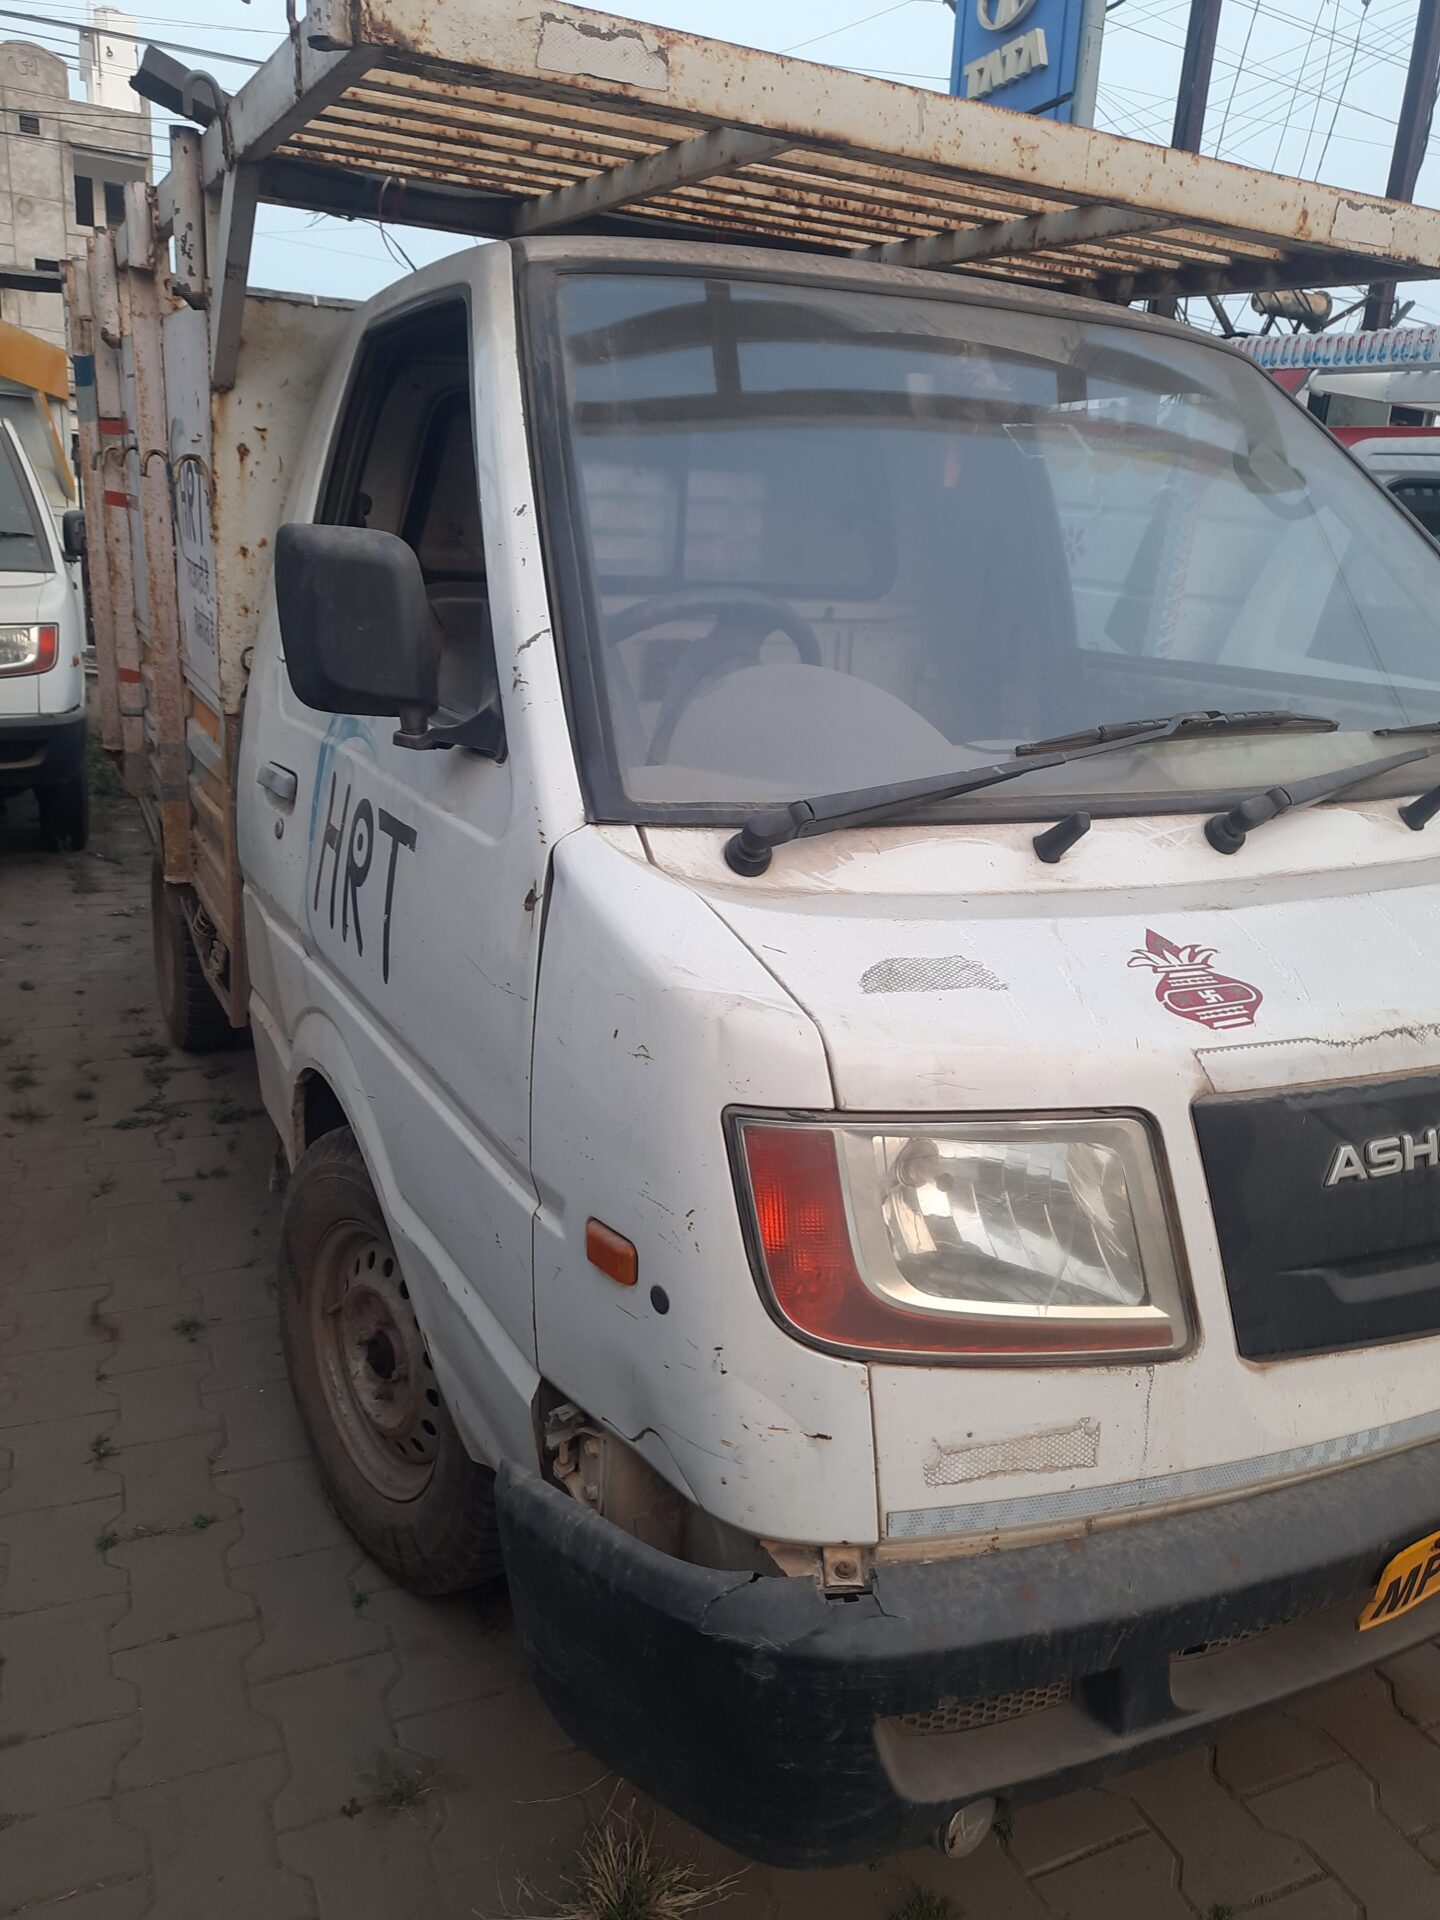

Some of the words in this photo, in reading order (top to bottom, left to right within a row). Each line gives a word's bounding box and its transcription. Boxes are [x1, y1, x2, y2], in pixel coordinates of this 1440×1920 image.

[964, 28, 1048, 99] TATA
[314, 771, 418, 984] HRT
[1325, 1128, 1440, 1187] ASH
